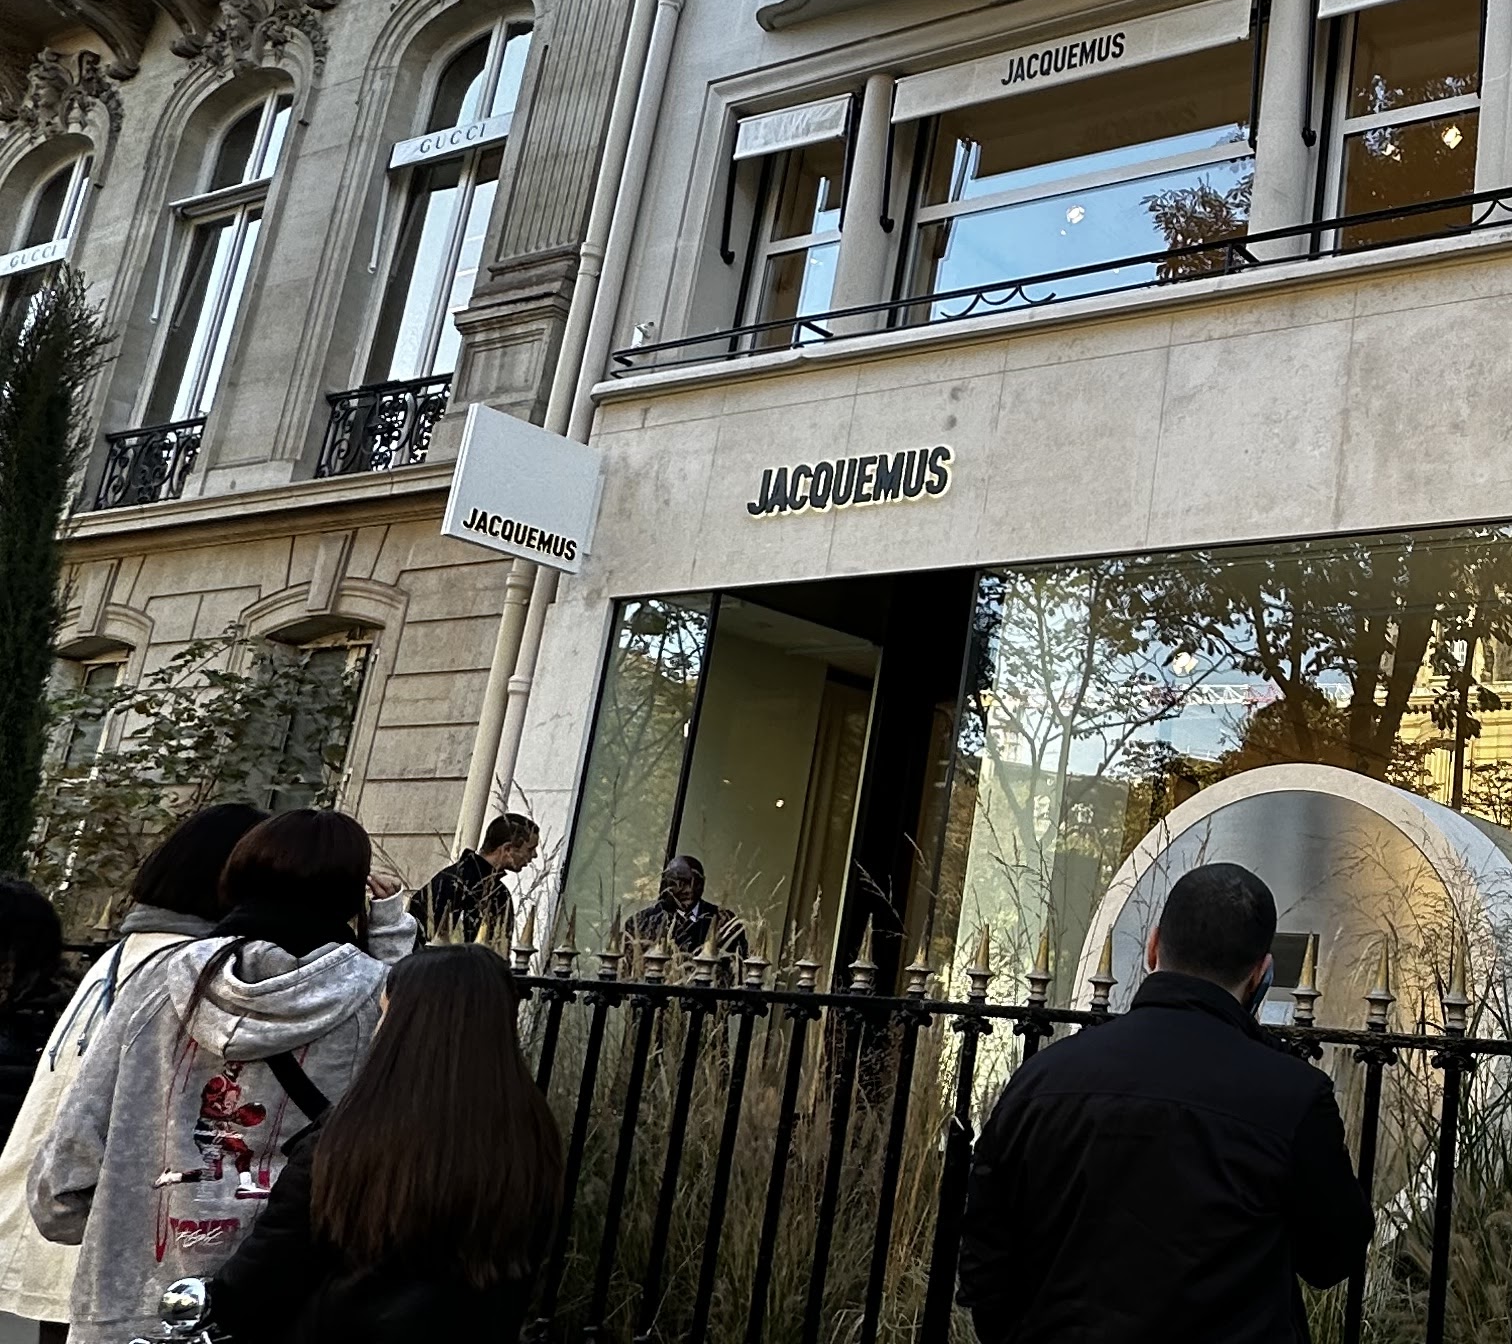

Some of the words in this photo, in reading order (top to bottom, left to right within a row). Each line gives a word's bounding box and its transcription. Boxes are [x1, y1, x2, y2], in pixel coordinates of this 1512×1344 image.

[1001, 32, 1126, 86] JACQUEMUS
[419, 123, 487, 154] GUCCI
[9, 244, 58, 268] GUCCI
[747, 445, 951, 516] JACQUEMUS
[462, 507, 578, 561] JACQUEMUS
